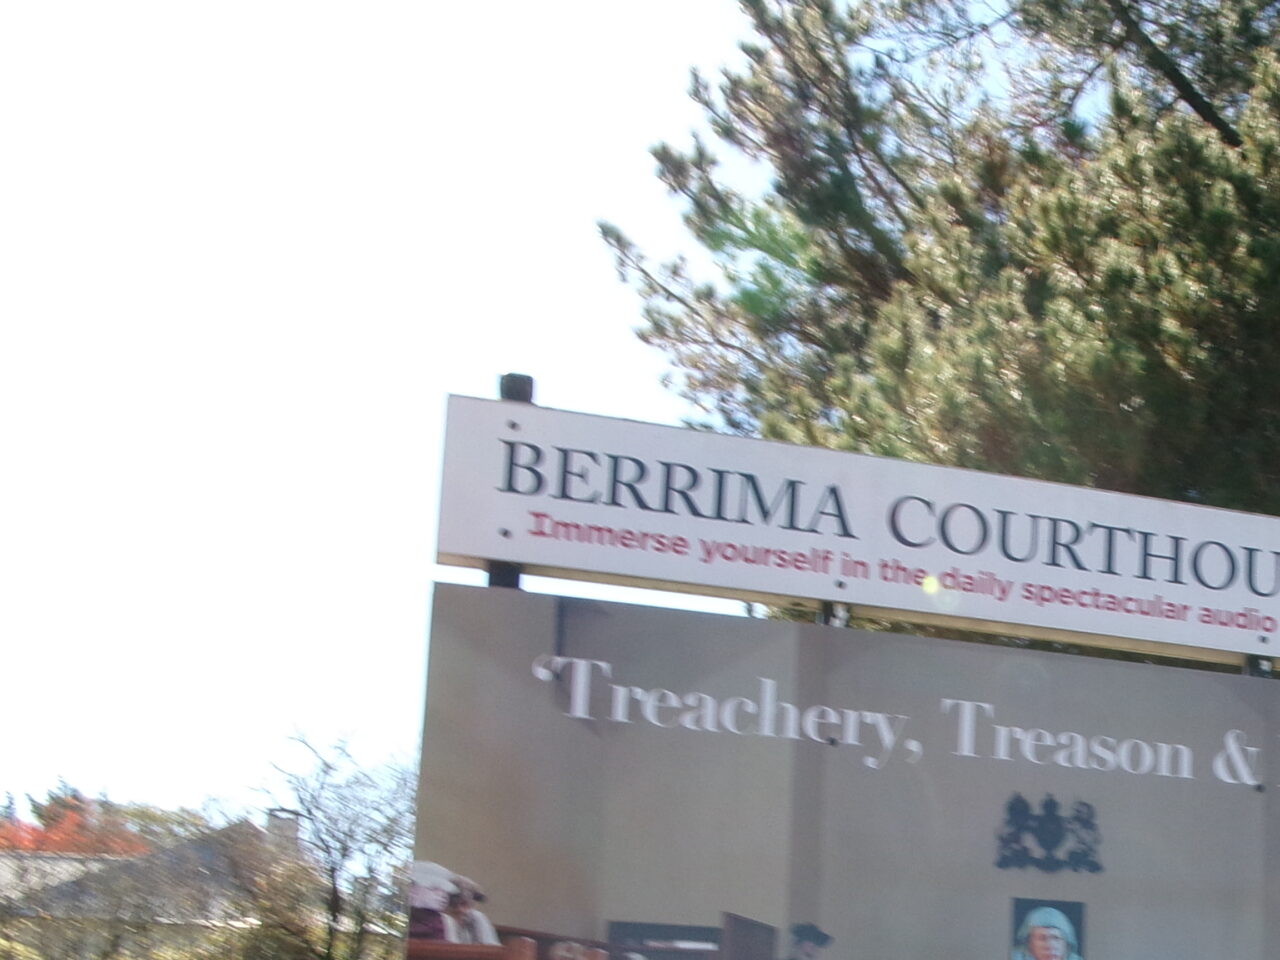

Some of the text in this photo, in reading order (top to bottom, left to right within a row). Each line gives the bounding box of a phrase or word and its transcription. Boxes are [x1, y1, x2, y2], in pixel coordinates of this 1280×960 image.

[496, 437, 859, 540] BERRIMA
[527, 510, 689, 556] Immerse
[698, 538, 834, 577] yourself
[840, 551, 870, 581] in
[879, 557, 926, 587] the
[937, 565, 1014, 602] daily
[1022, 581, 1192, 623] spectacular
[1199, 605, 1278, 634] audio
[940, 697, 1197, 780] Treason
[1211, 728, 1263, 787] &
